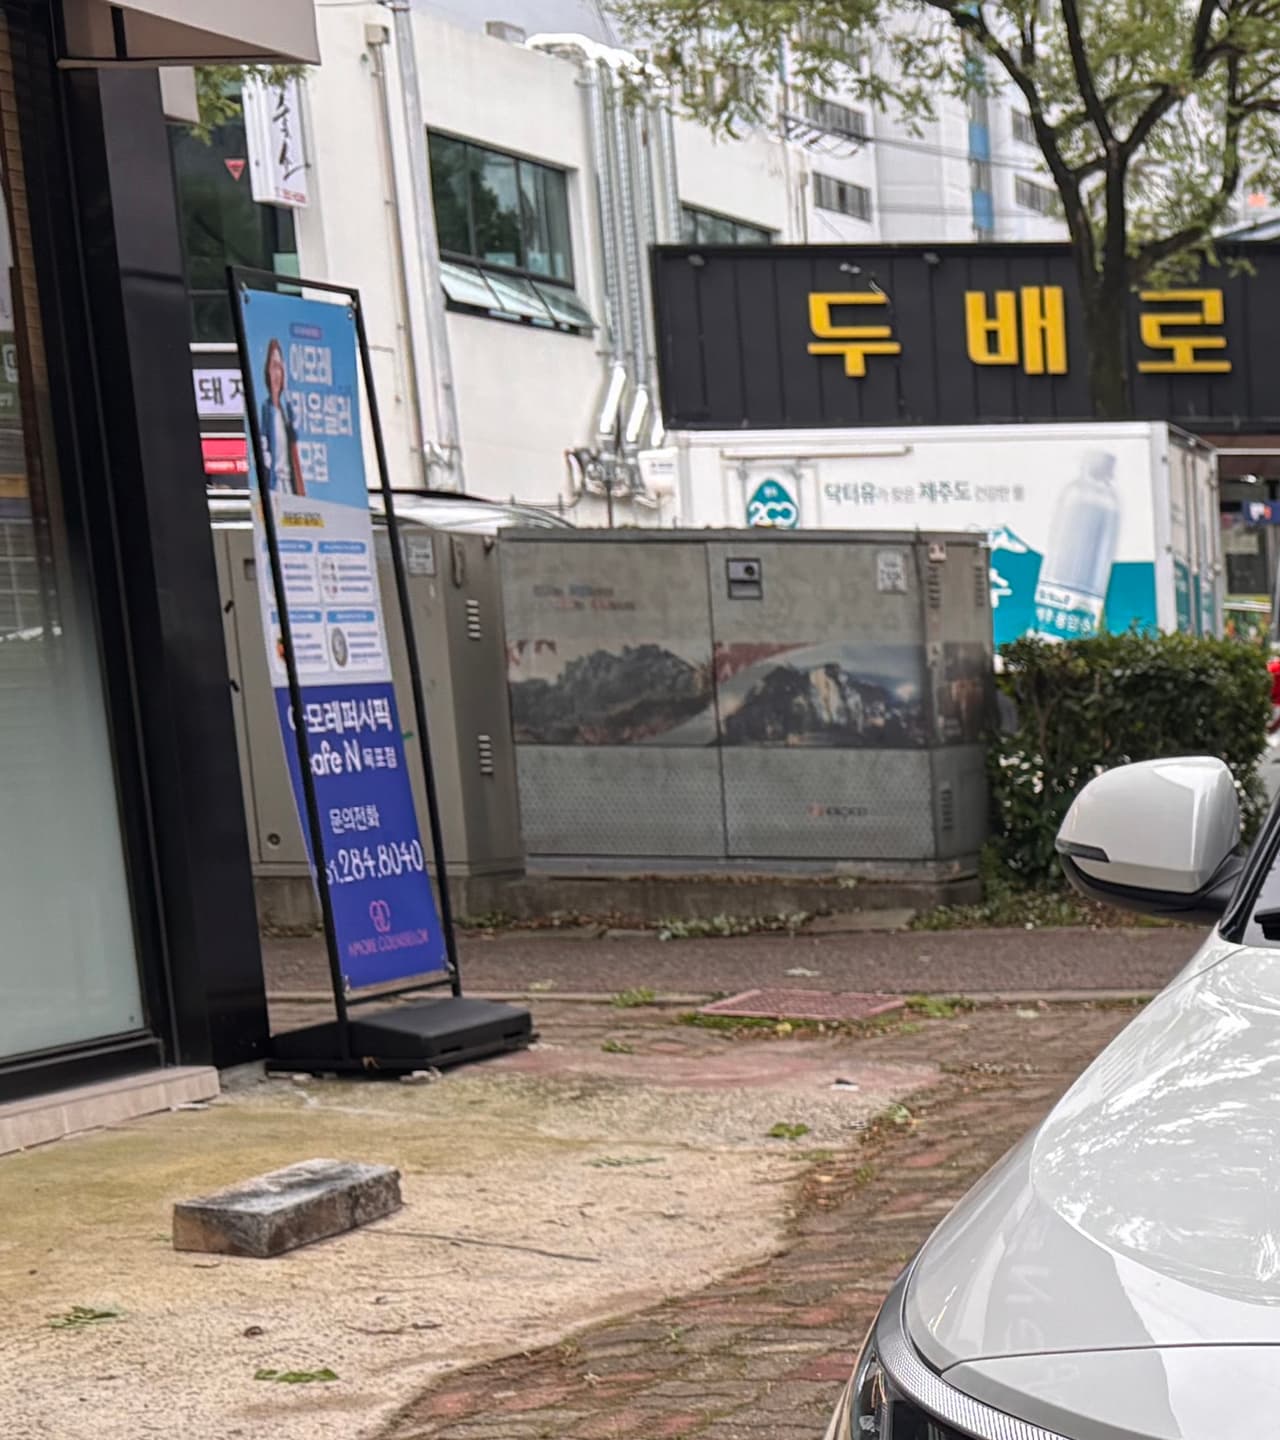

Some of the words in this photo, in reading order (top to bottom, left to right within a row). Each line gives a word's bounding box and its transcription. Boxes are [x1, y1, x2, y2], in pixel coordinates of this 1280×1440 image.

[289, 343, 333, 387] 아모레
[296, 440, 329, 484] 모집
[310, 740, 344, 776] afe
[343, 740, 363, 773] N
[329, 804, 380, 834] 문의전화
